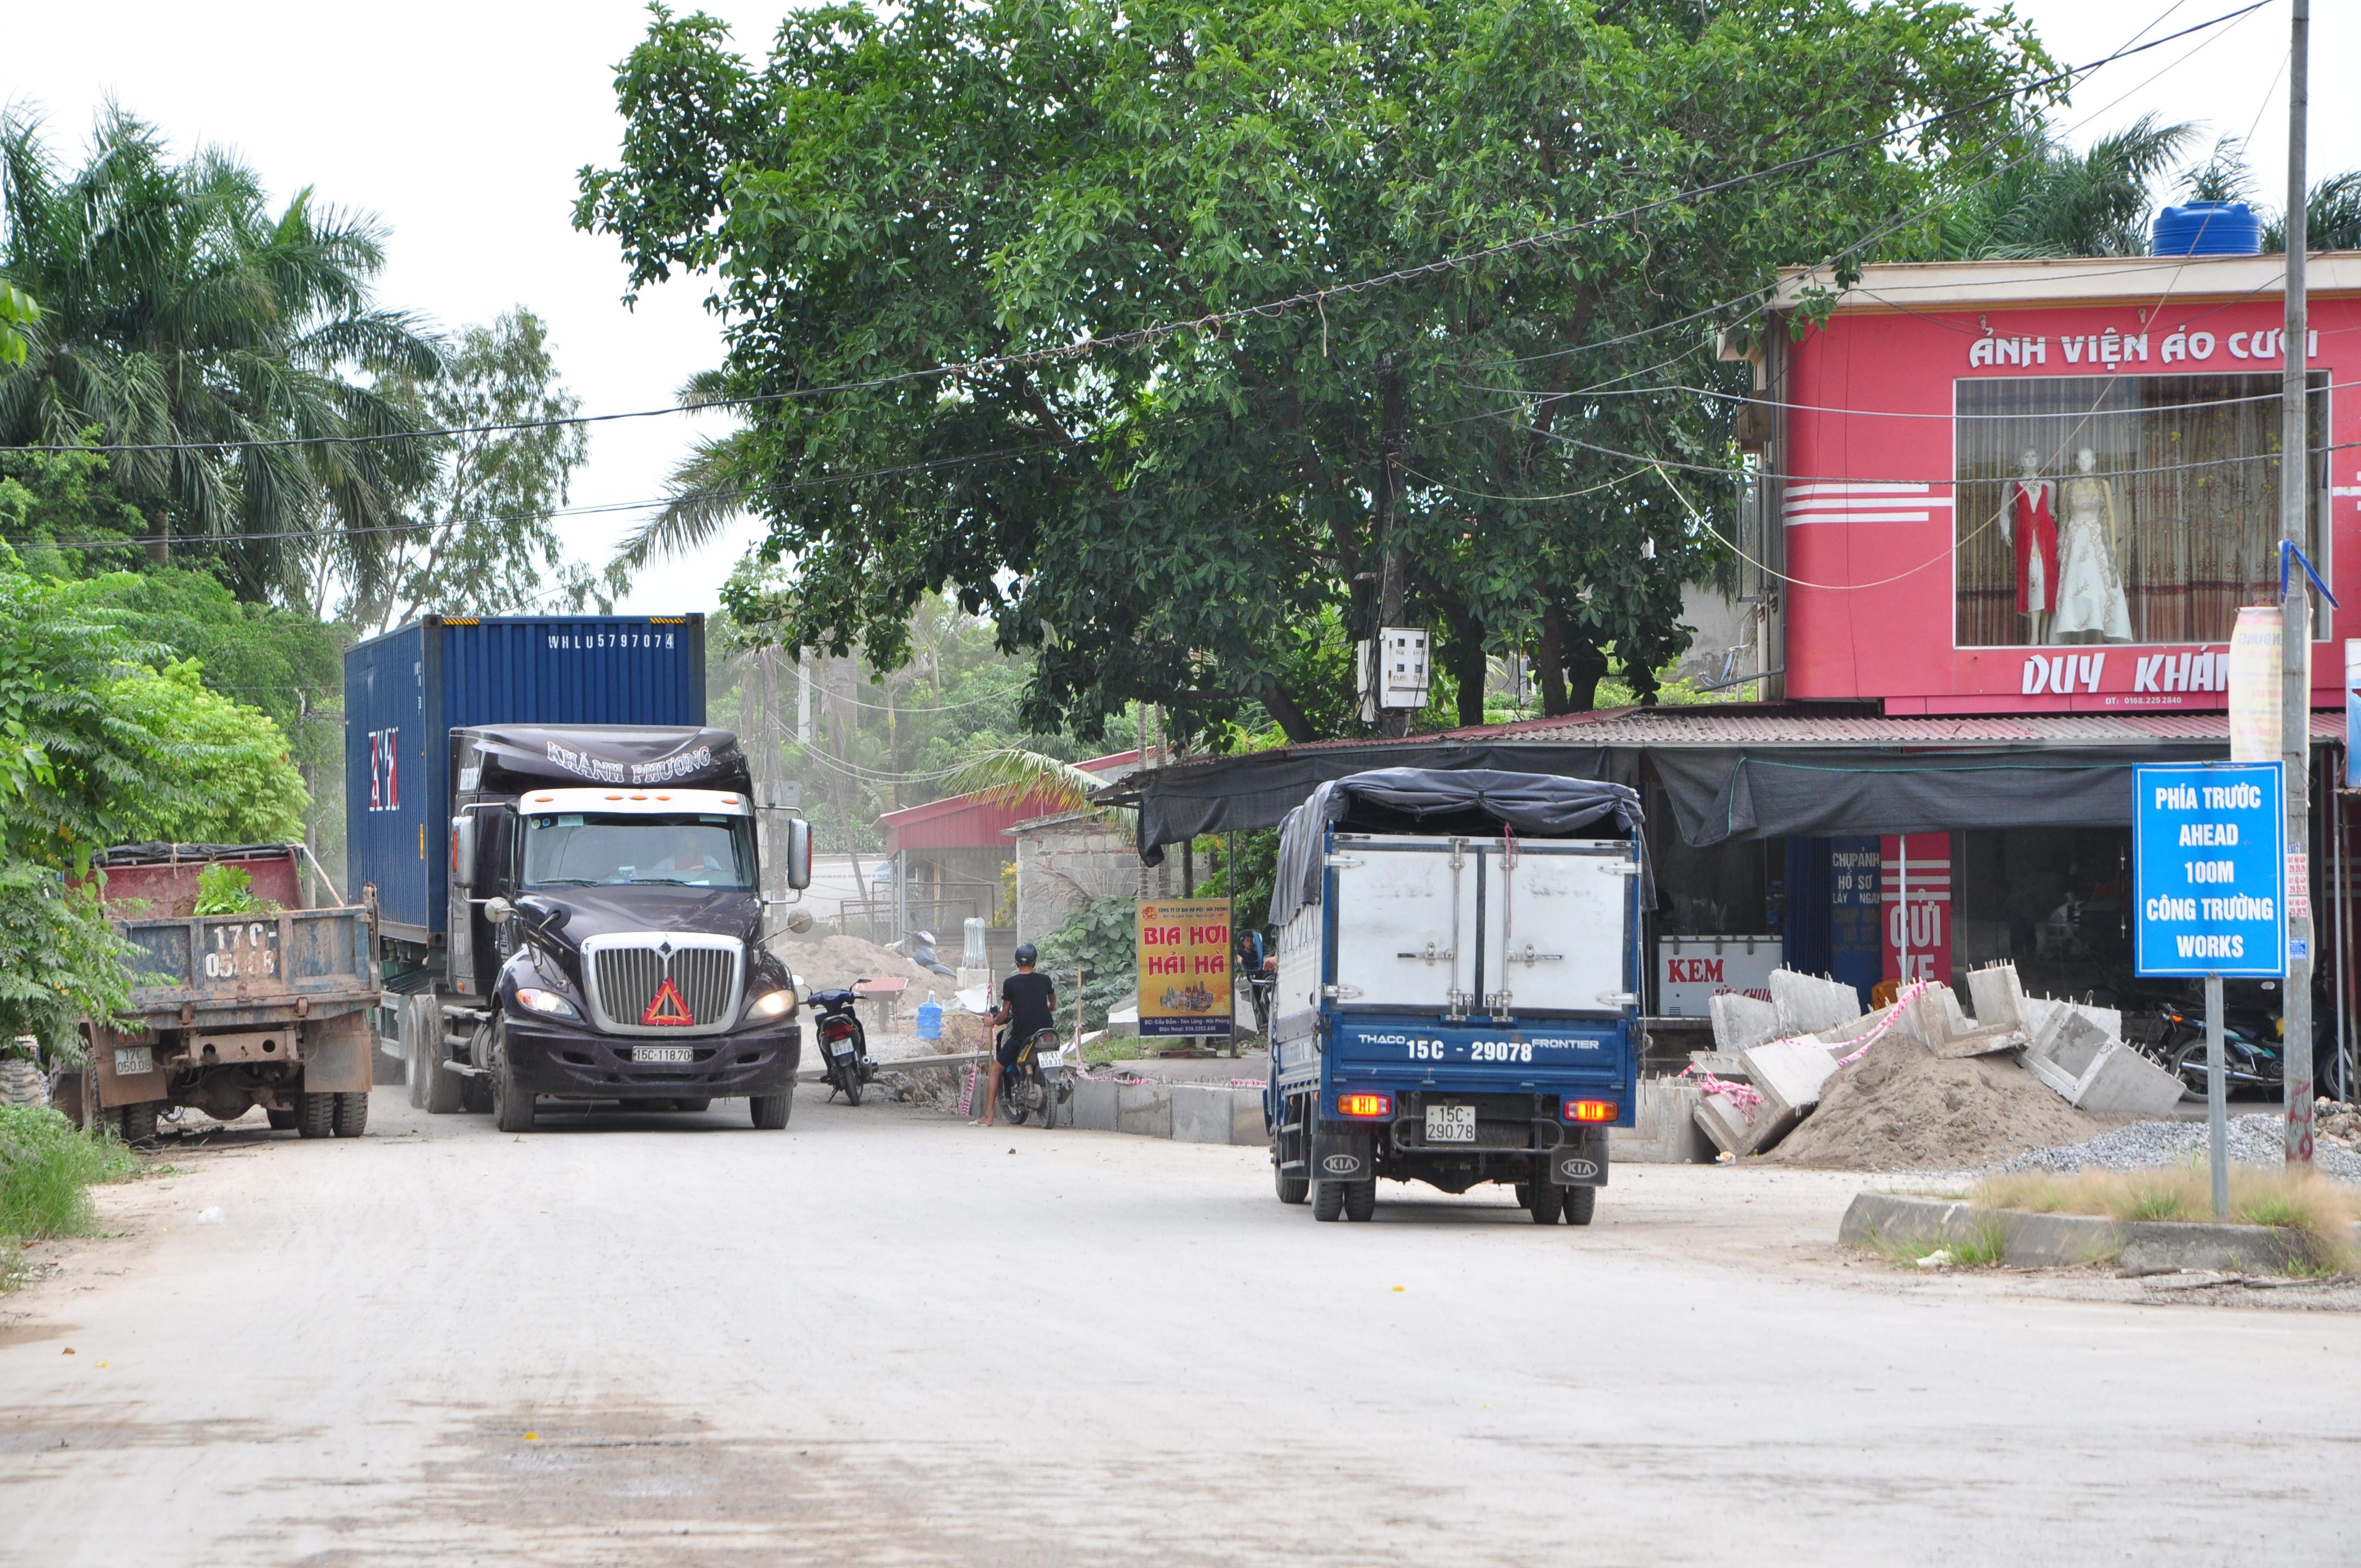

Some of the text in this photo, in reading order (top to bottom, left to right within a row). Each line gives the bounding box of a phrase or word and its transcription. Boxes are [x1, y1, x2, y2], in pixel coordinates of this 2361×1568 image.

[1969, 325, 2318, 371] ẢNH VIỆN ÁO CƯI
[2021, 652, 2106, 694] DUY
[547, 741, 711, 784] KHÁNH PHƯƠNG
[2155, 782, 2261, 810] PHÍA TRƯỚC
[2179, 824, 2239, 846] AHEAD
[1858, 874, 1873, 889] SƠ
[2185, 861, 2234, 884] 100M
[2147, 892, 2274, 921] CÔNG TRƯỜNG
[1144, 925, 1227, 946] BIA HƠI
[2176, 935, 2244, 958] WORKS
[1149, 951, 1225, 976] HẢI HÀ
[1668, 959, 1724, 983] KEM
[1358, 1034, 1405, 1044] THACO
[1407, 1040, 1444, 1059] 15C
[1471, 1041, 1532, 1062] 29078
[1532, 1039, 1599, 1049] FRONTIER
[1440, 1107, 1463, 1123] 15C
[1428, 1124, 1473, 1139] 290.78
[1329, 1158, 1354, 1169] KIA
[1568, 1163, 1592, 1174] KIA
